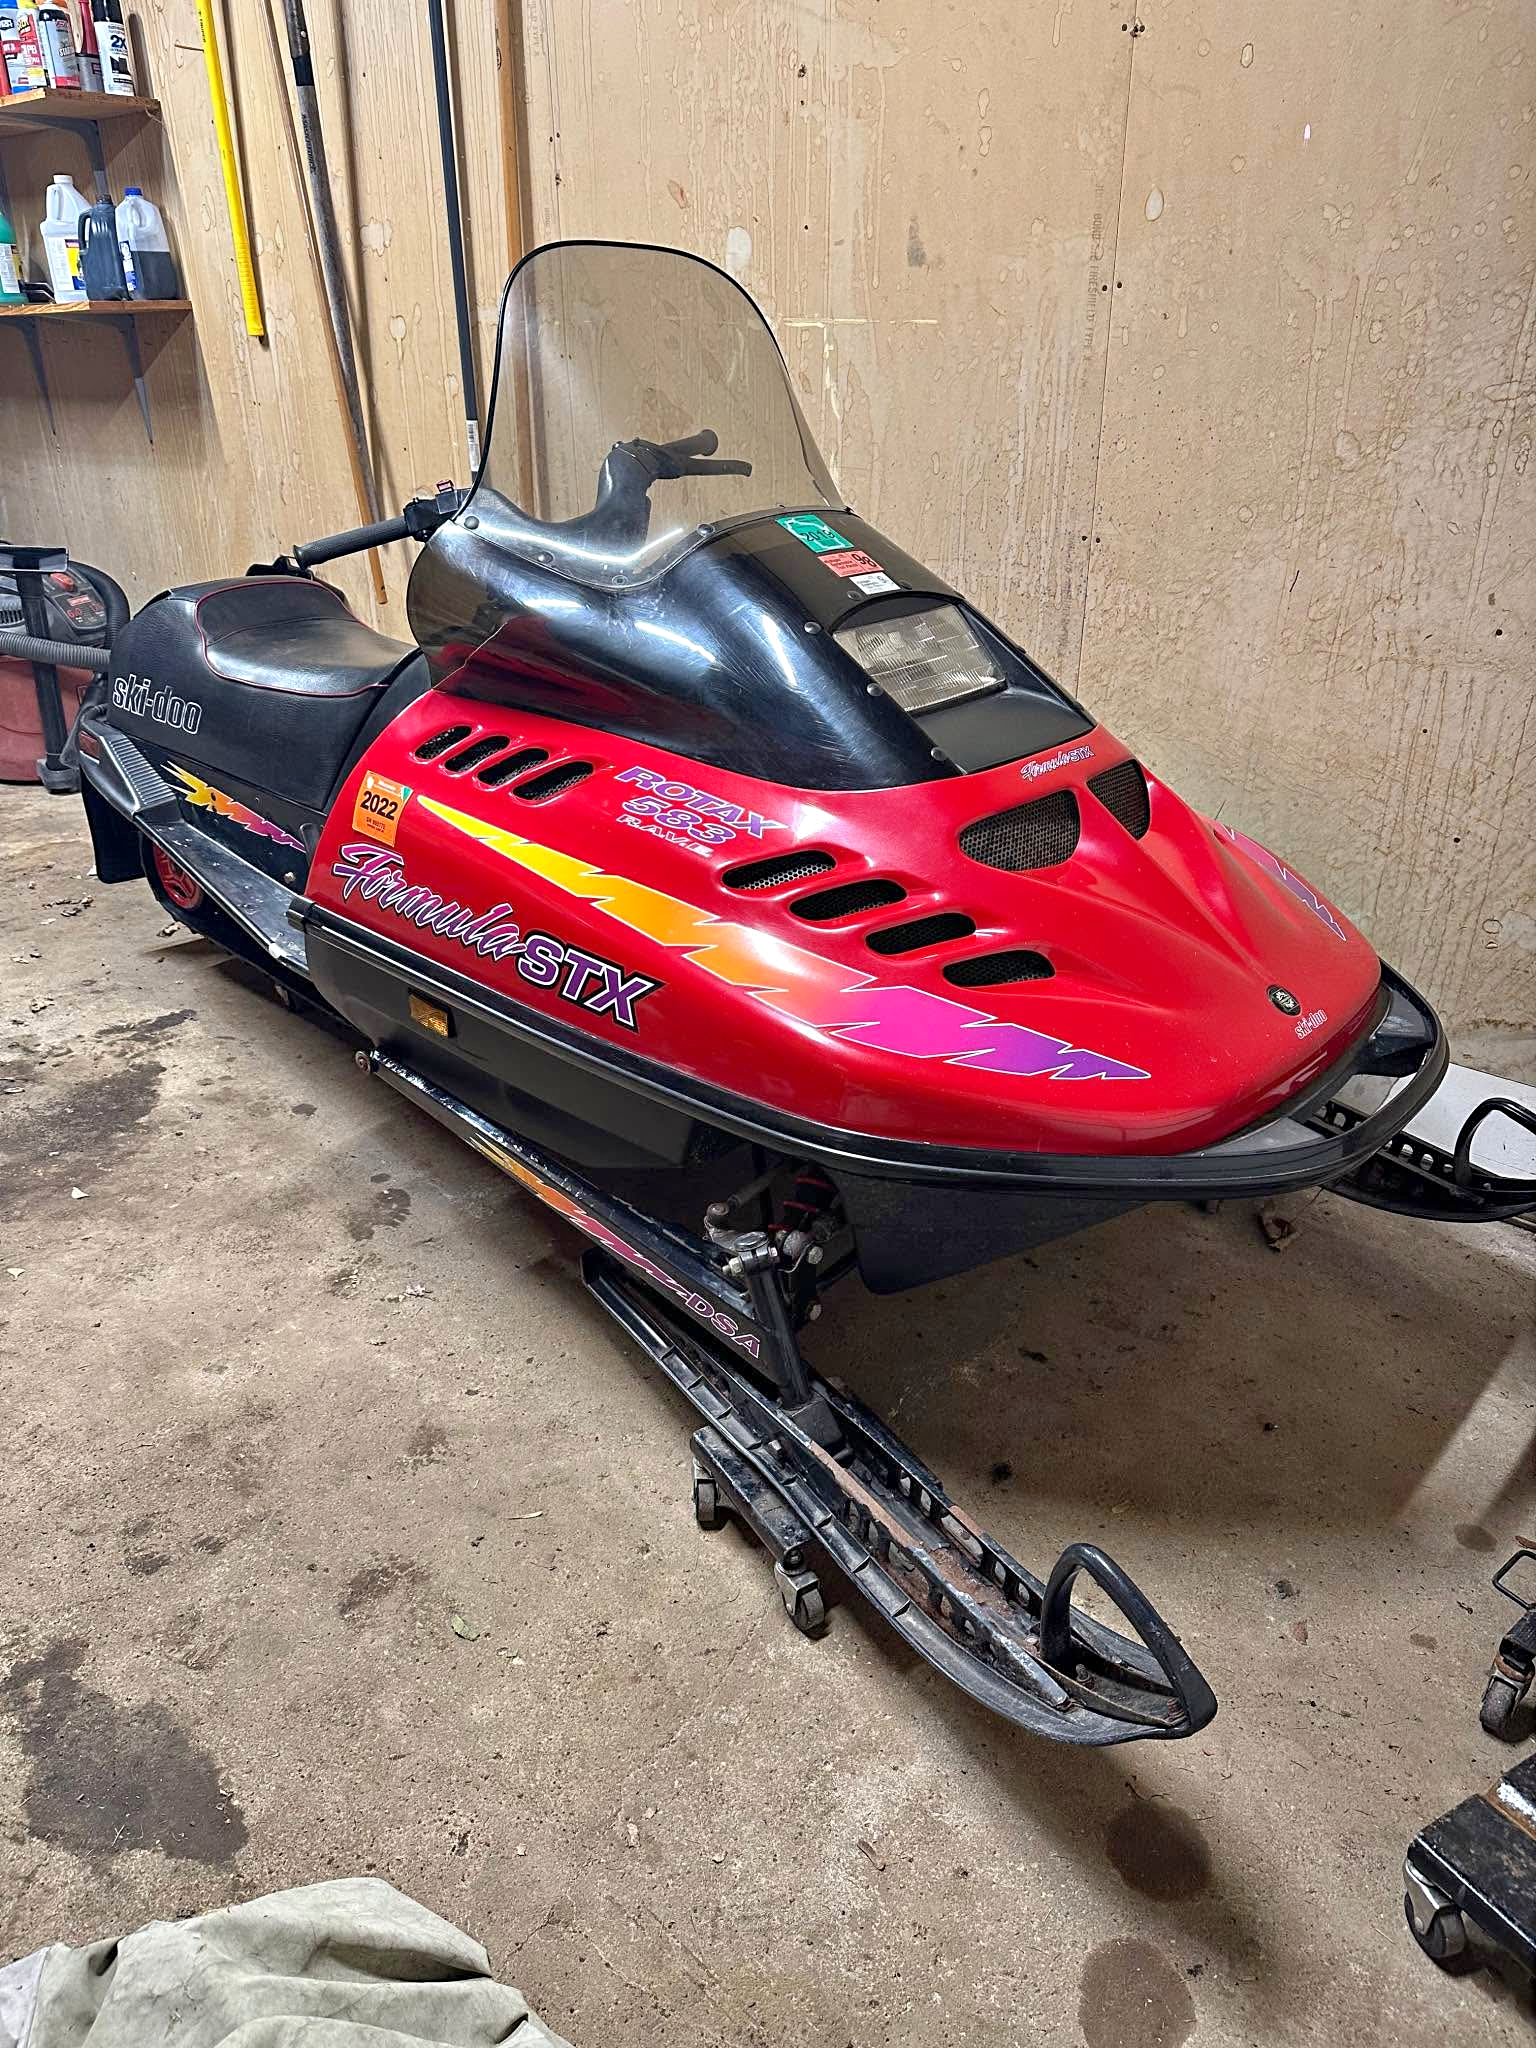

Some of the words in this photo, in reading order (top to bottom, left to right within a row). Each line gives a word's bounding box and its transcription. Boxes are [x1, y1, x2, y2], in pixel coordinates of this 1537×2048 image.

[851, 553, 878, 568] 98
[113, 674, 202, 735] ski-doo
[1020, 750, 1072, 783] Formula
[1069, 745, 1095, 762] STX
[360, 790, 398, 821] 2022
[613, 766, 789, 839] ROTAX
[622, 795, 737, 844] 583
[332, 843, 526, 962] Formula
[516, 932, 655, 1029] STX
[1294, 1009, 1328, 1040] ski-doo
[684, 1292, 761, 1359] DSA
